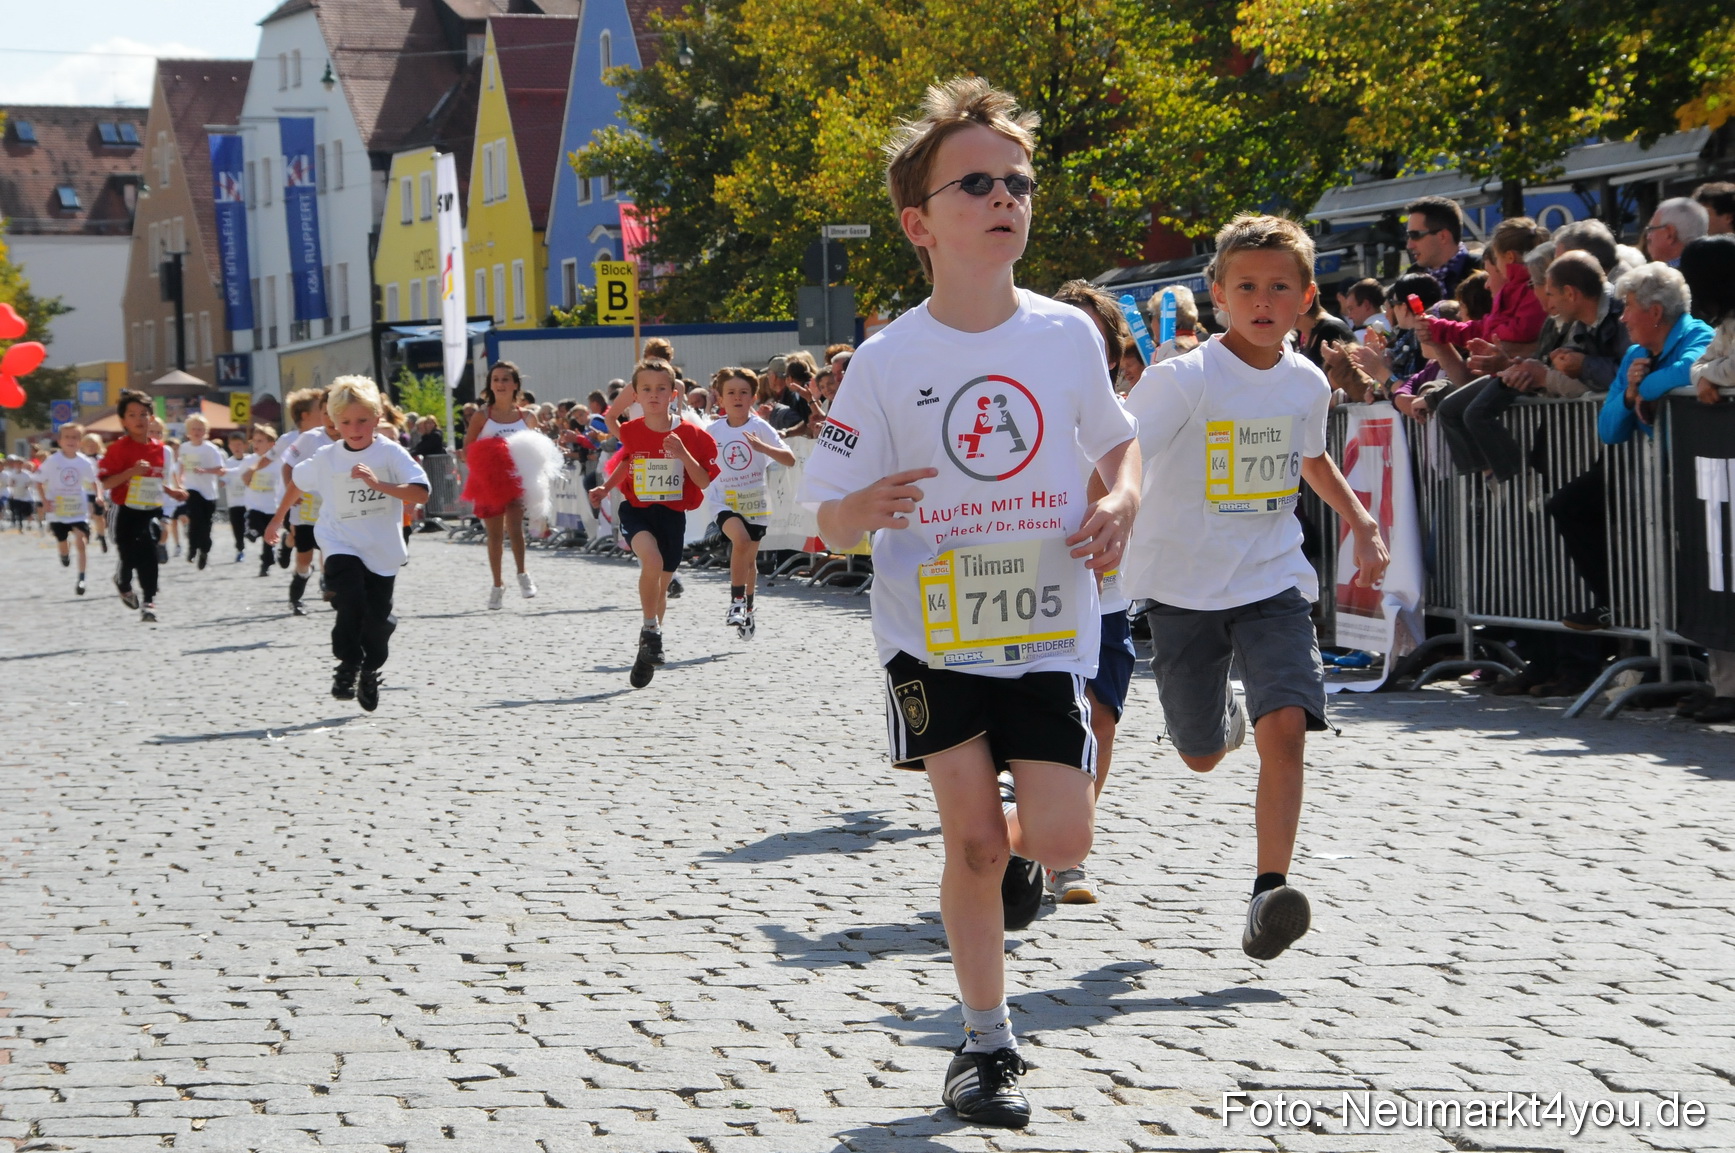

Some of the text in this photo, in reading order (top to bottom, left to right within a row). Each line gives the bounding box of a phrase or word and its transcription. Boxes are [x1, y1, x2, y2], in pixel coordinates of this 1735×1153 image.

[300, 193, 318, 264] RUPPERT
[413, 248, 436, 271] HOTEL
[600, 264, 633, 276] Block
[608, 280, 628, 310] B
[234, 402, 246, 417] C
[916, 396, 940, 407] erima
[1239, 427, 1282, 445] Moritz
[647, 461, 668, 471] Jonas
[1211, 456, 1226, 471] K4
[1241, 452, 1299, 482] 7076
[648, 475, 680, 487] 7146
[919, 491, 1068, 524] LAUFEN MIT HERZ
[950, 524, 983, 537] Heck
[996, 521, 1015, 532] Dr.
[1018, 517, 1062, 530] Röschl
[960, 553, 1025, 578] Tilman
[928, 592, 947, 612] K4
[965, 584, 1063, 625] 7105
[1021, 638, 1075, 654] PFLEIDERER
[944, 651, 984, 663] BOCK
